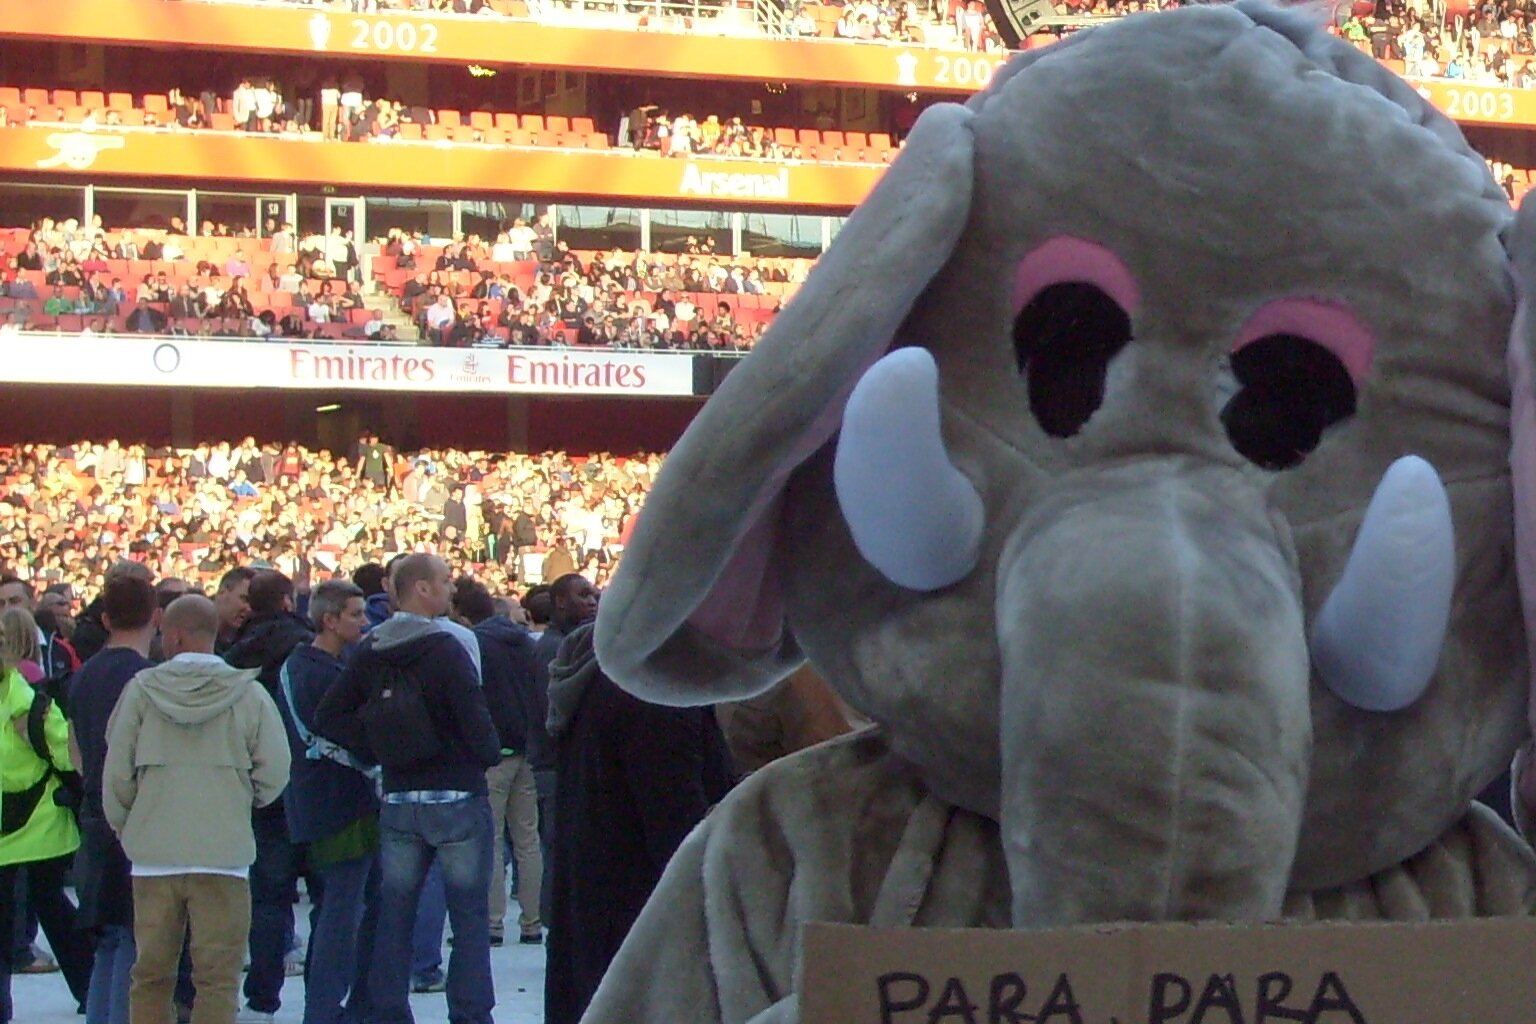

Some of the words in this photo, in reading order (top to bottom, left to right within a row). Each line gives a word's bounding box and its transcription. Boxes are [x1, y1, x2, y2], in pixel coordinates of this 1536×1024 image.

[351, 19, 438, 53] 2002
[934, 55, 1007, 86] 200
[1446, 88, 1514, 119] 2003
[680, 162, 789, 198] Arsenal
[289, 348, 435, 382] Emirates
[507, 353, 646, 389] Emirates
[877, 971, 1085, 1024] PARA
